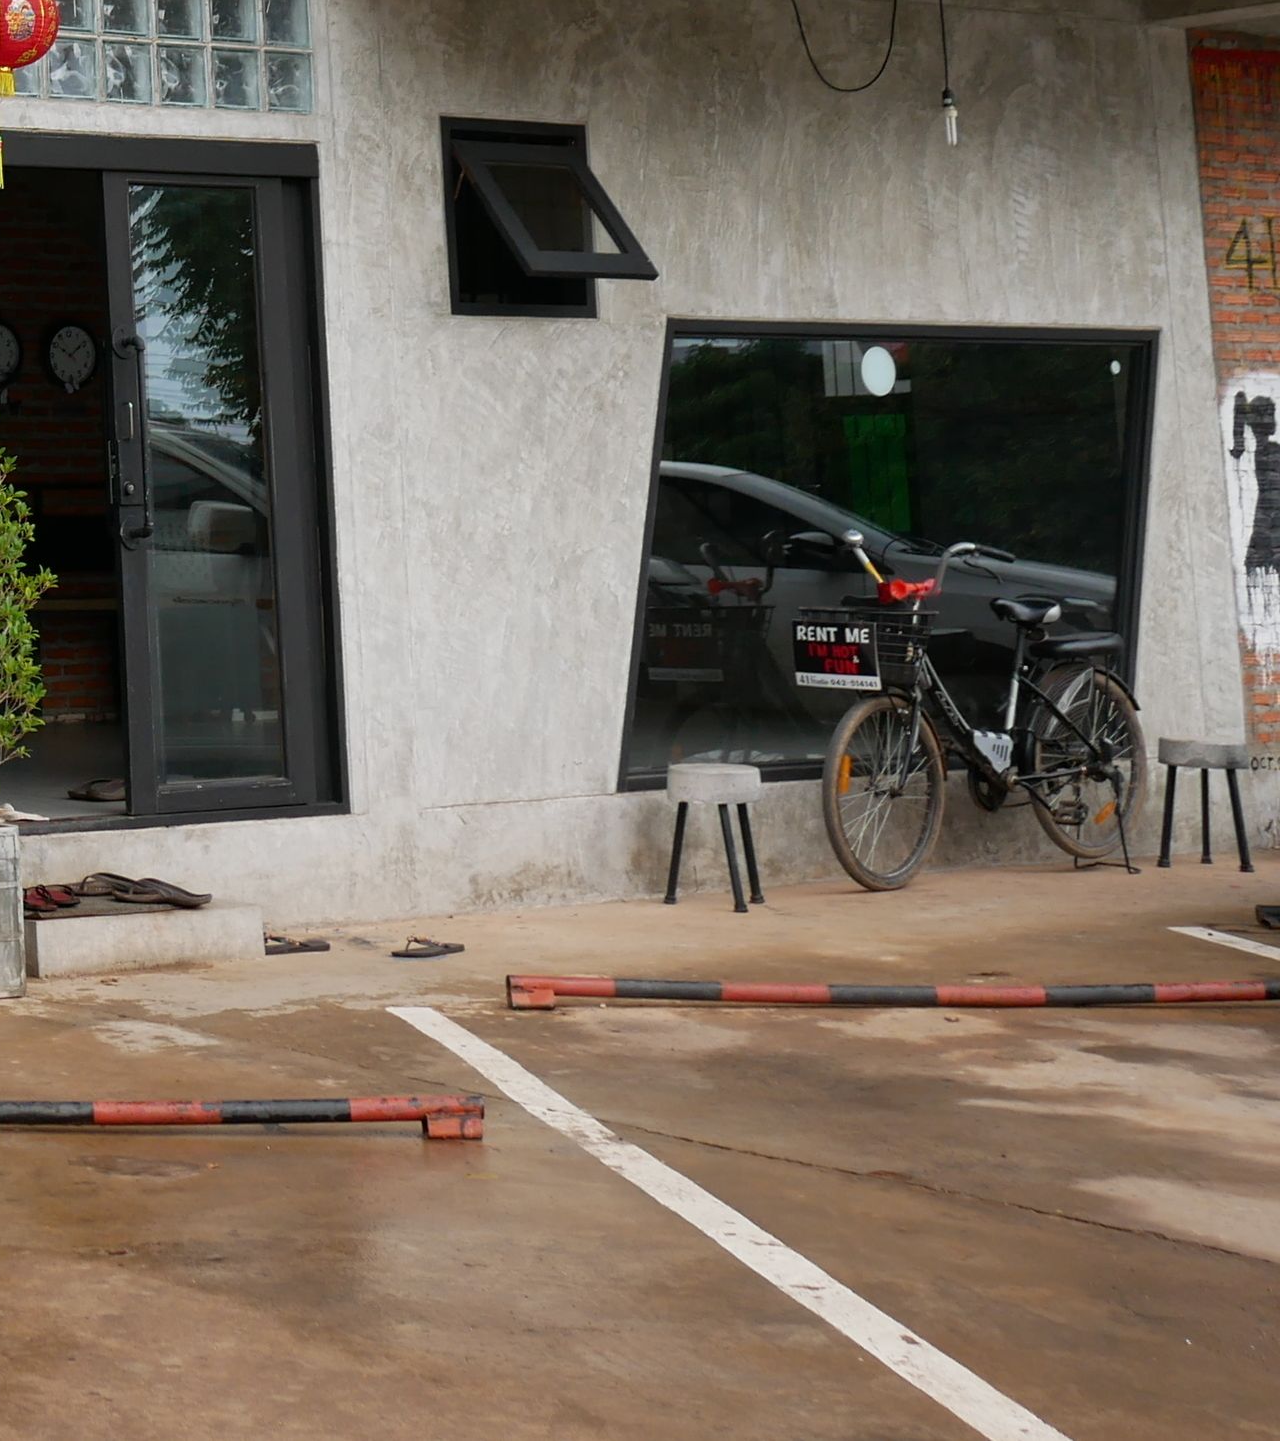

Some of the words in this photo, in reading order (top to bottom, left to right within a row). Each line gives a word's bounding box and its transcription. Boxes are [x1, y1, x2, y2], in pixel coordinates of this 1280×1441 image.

[796, 625, 838, 642] RENT
[844, 627, 870, 644] ME
[831, 644, 858, 658] HOT
[824, 658, 859, 674] FUN
